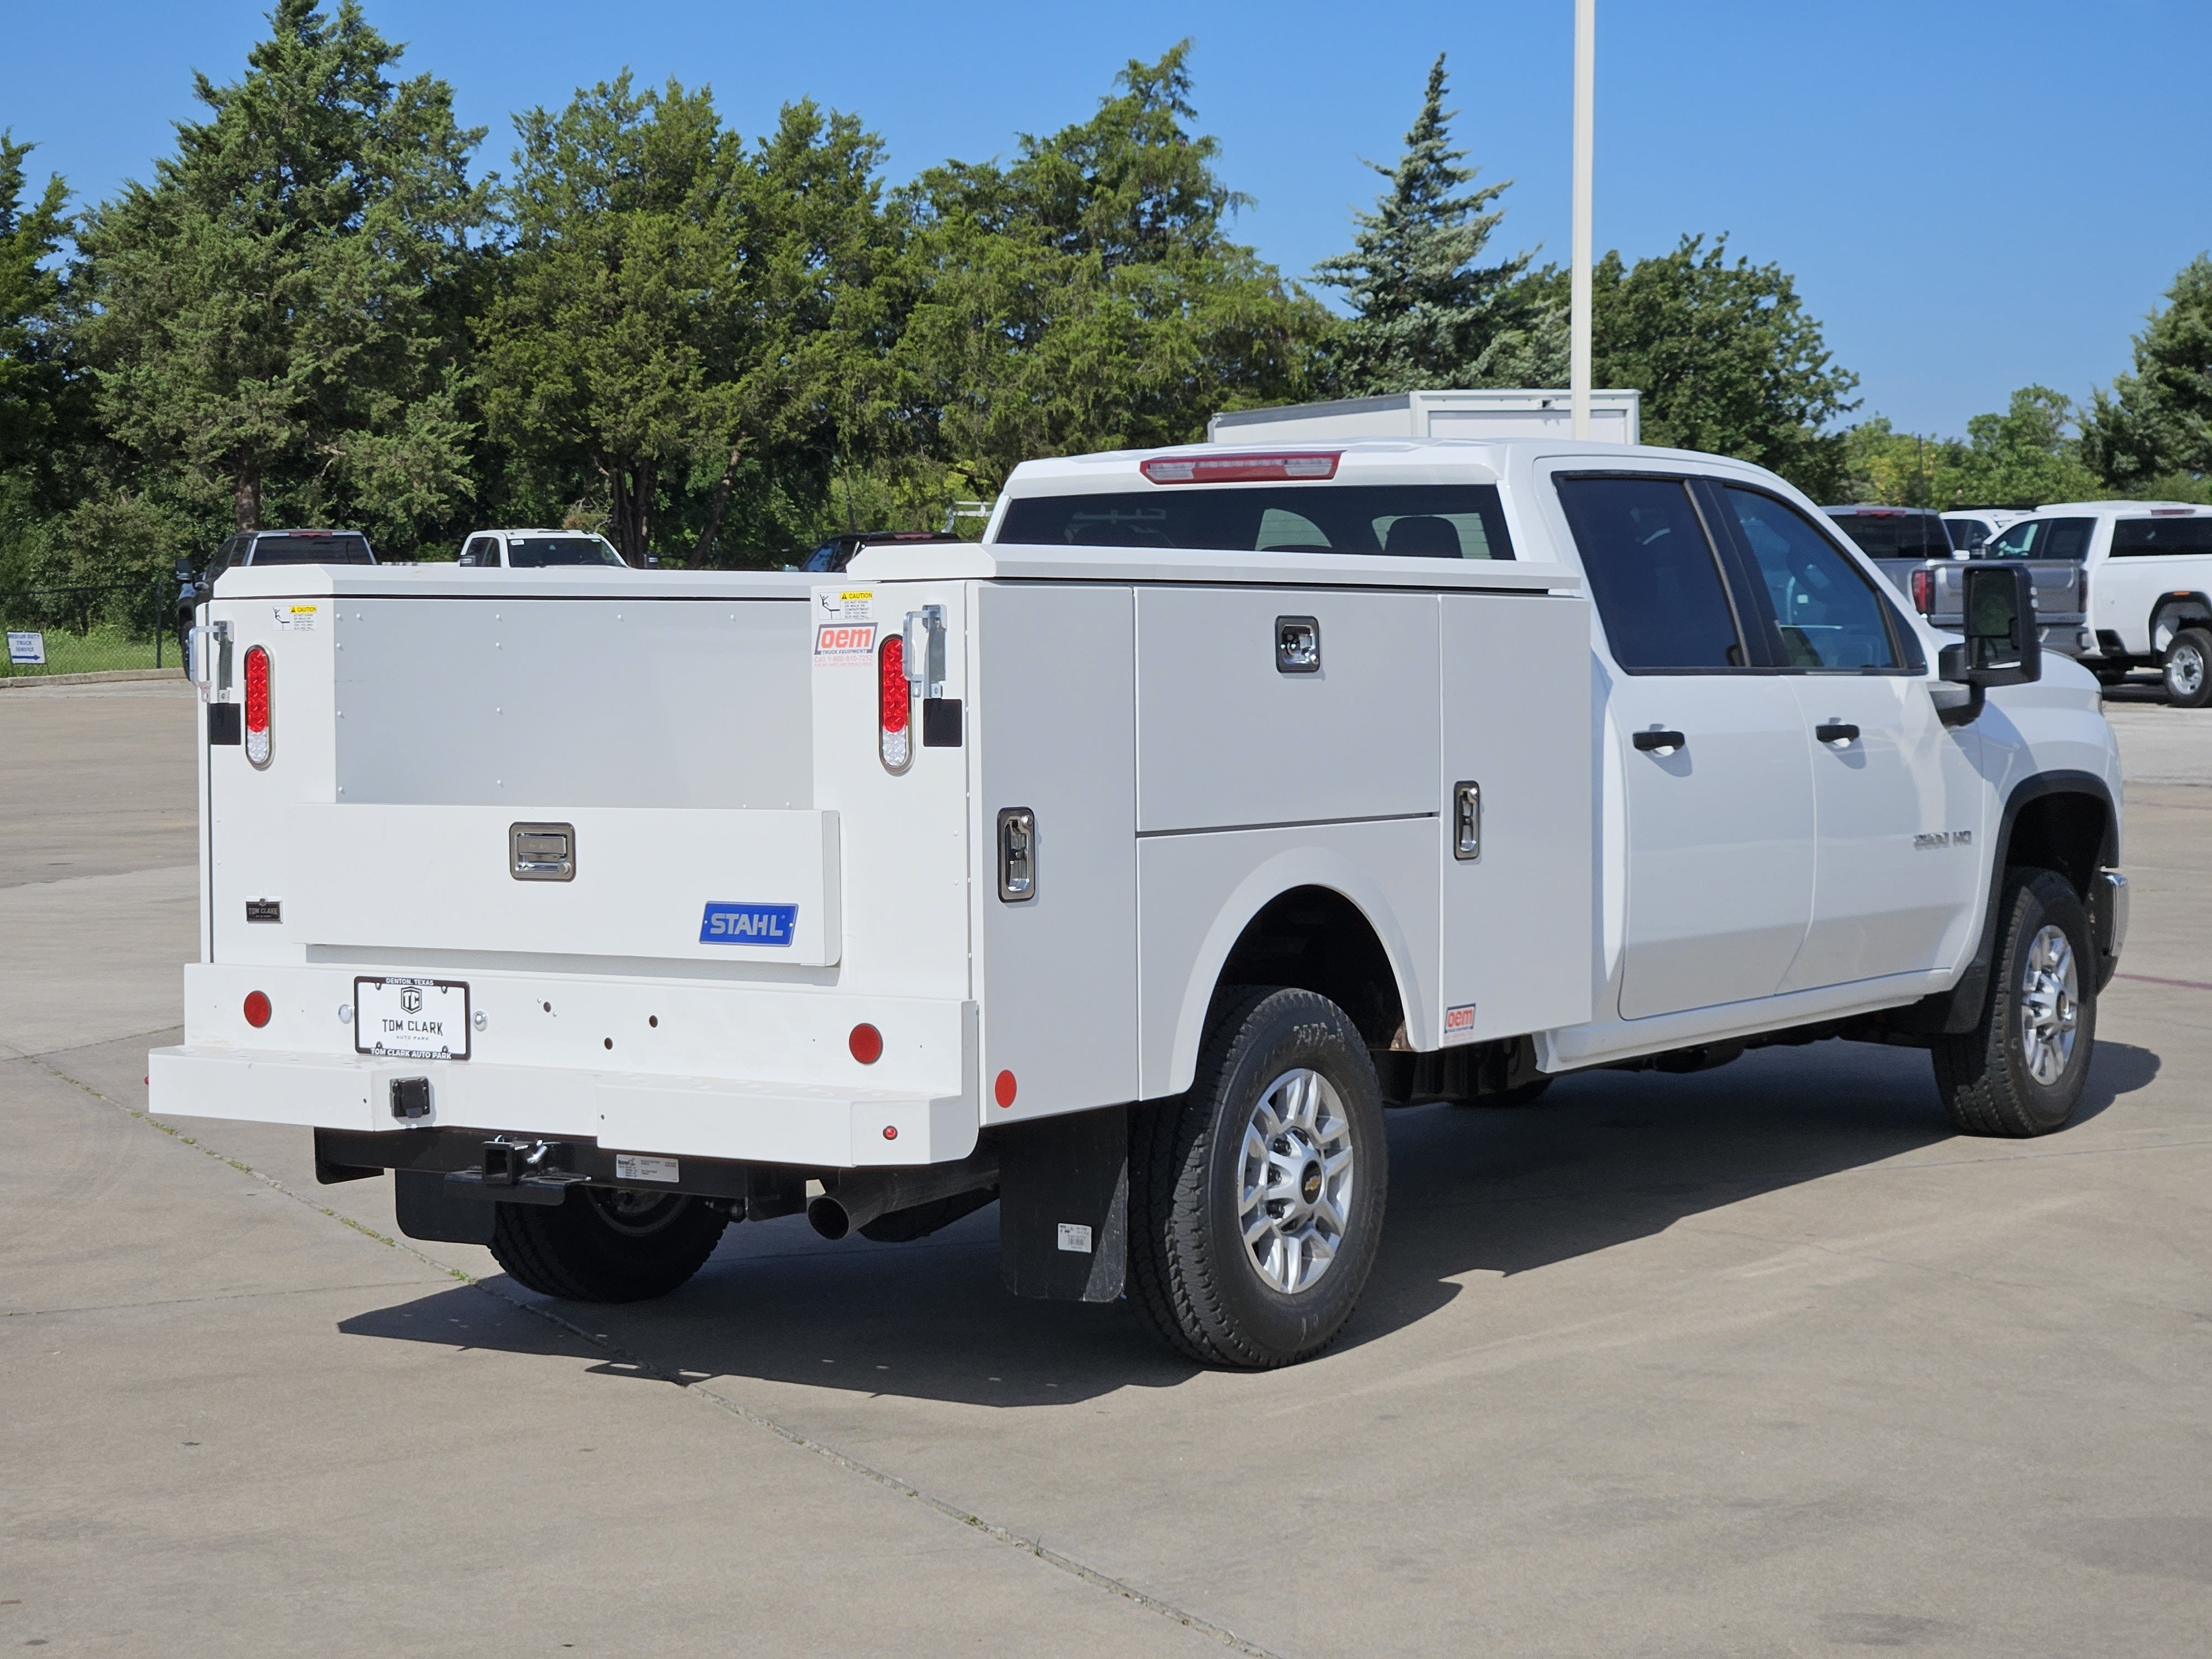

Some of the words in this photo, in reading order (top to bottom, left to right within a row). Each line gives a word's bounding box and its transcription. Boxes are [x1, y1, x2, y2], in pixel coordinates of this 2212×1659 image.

[821, 629, 872, 649] oem
[710, 912, 784, 936] STAHL
[1447, 1009, 1473, 1027] oem
[382, 1019, 404, 1032] TOM
[408, 1020, 444, 1036] CLARK
[388, 1049, 411, 1057] CLARK
